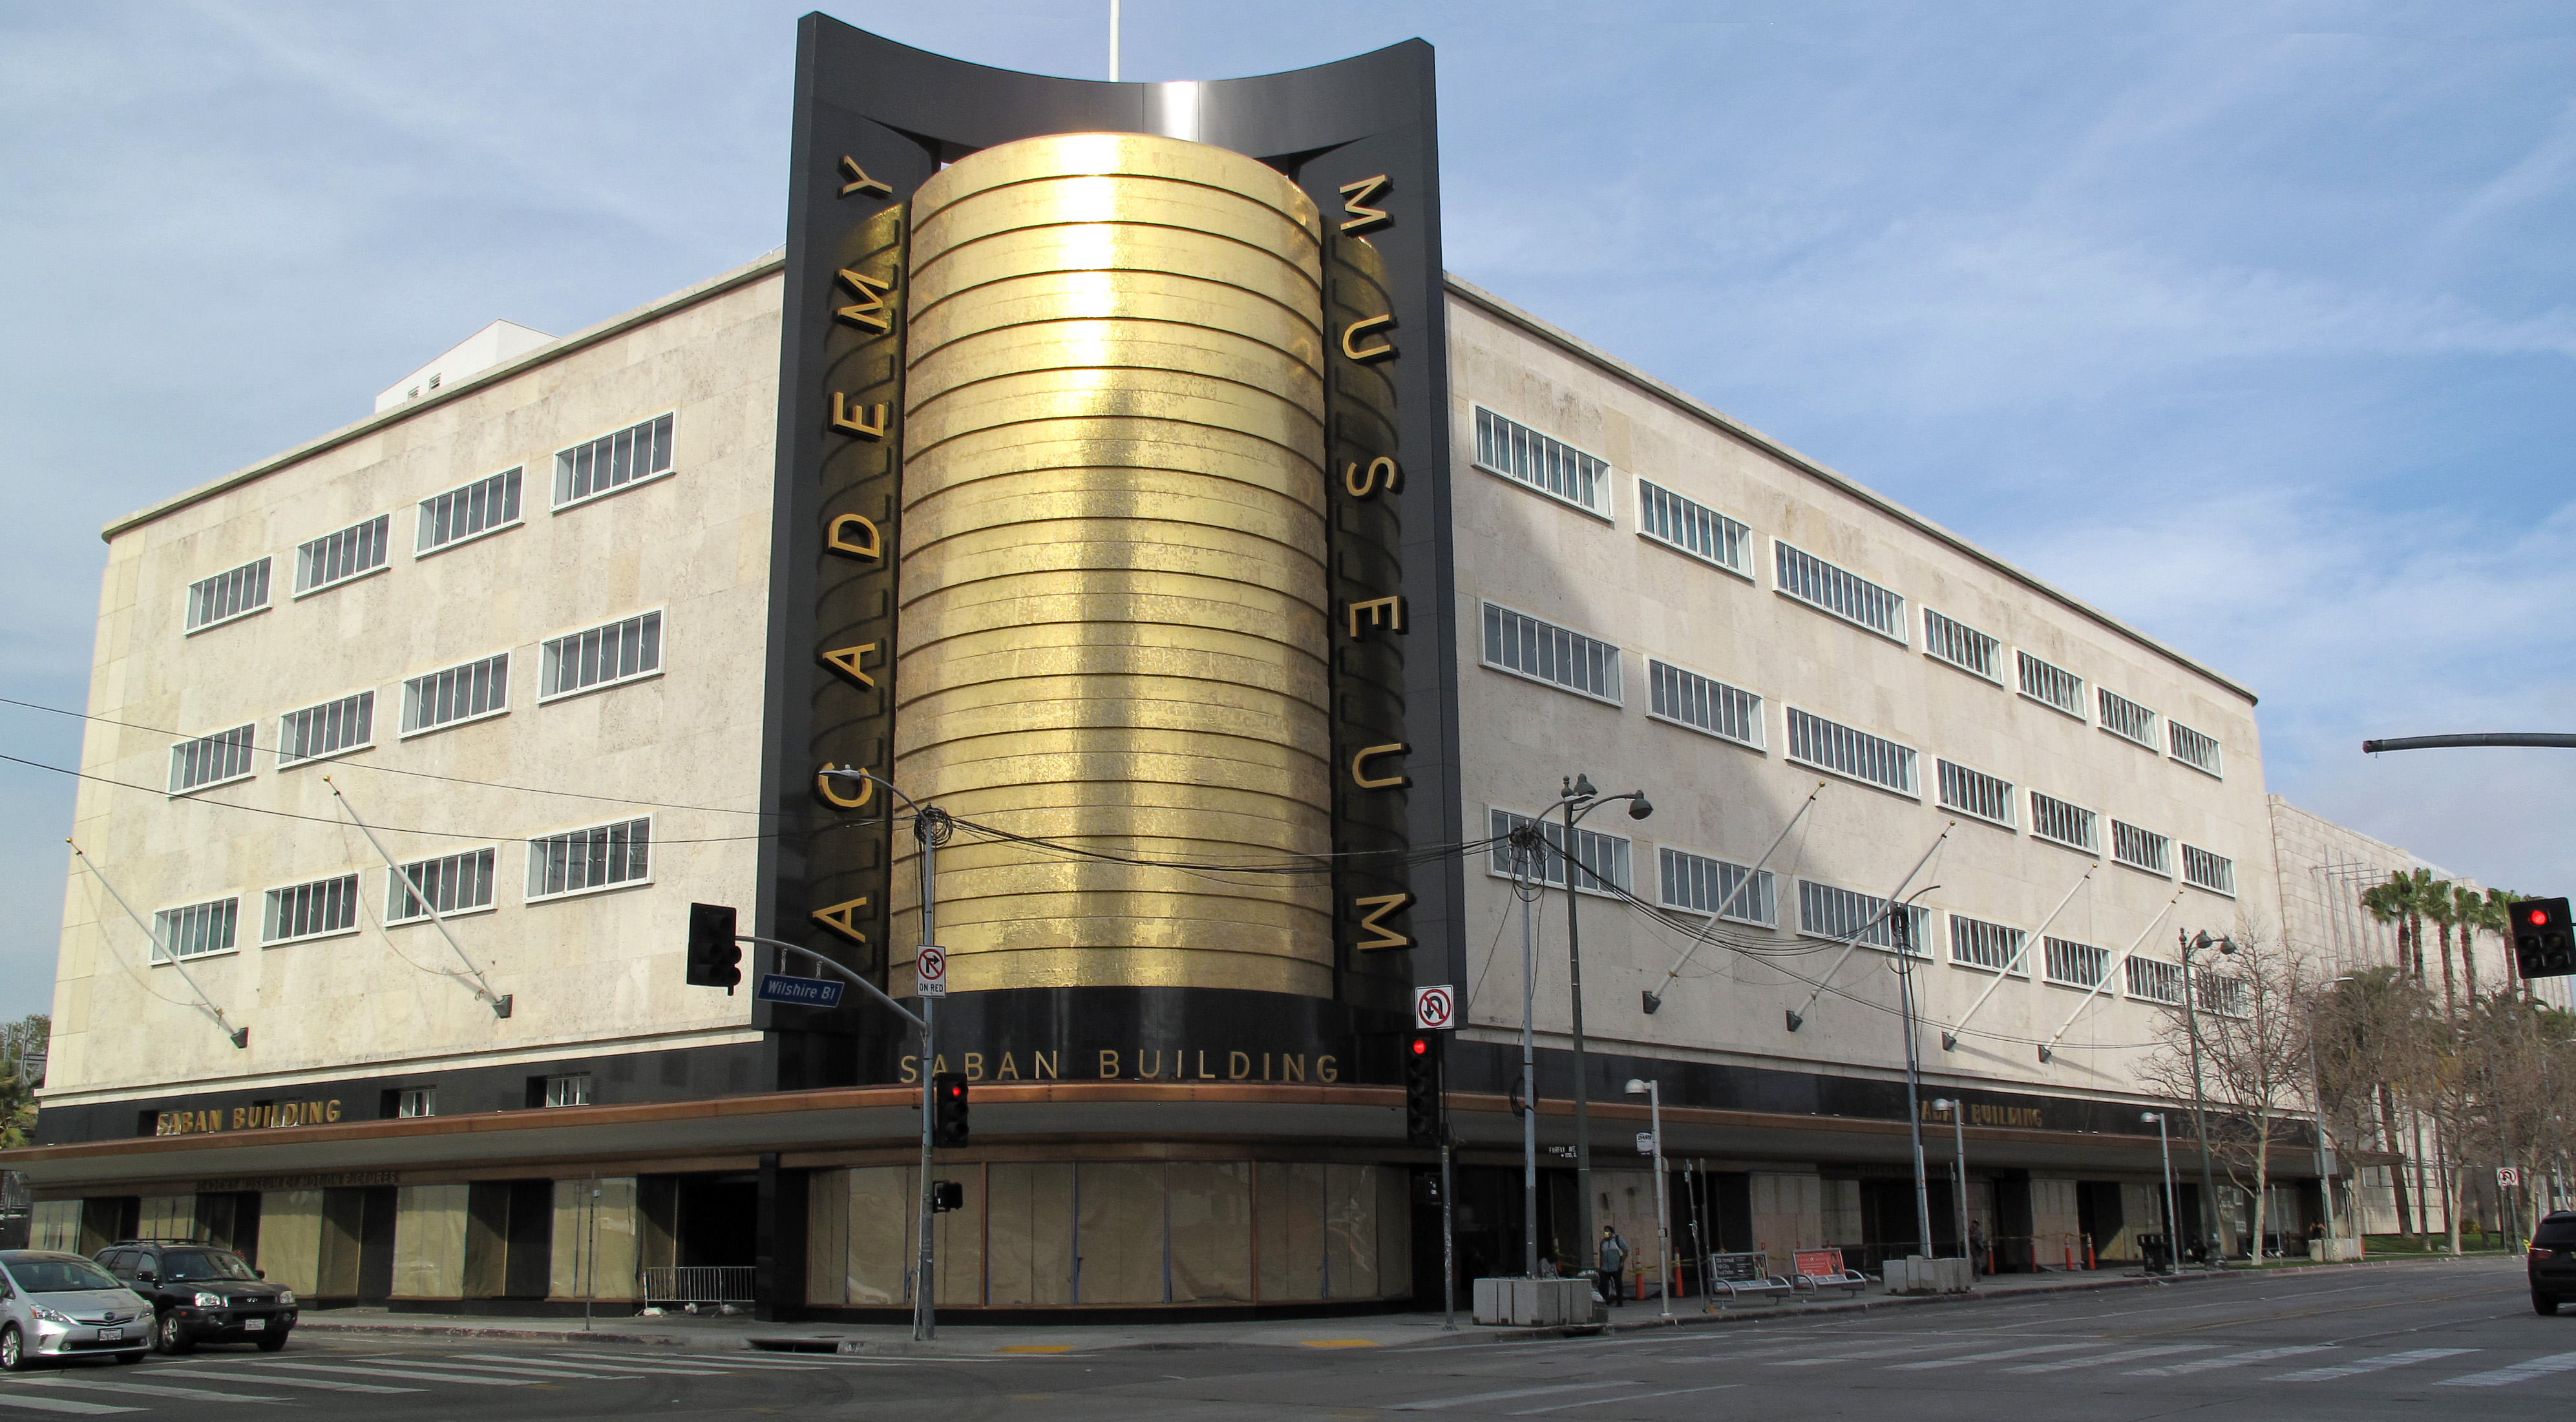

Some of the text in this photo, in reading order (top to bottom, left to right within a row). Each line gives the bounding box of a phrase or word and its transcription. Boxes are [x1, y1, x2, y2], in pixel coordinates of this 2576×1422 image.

[810, 154, 893, 945] ACADEMY
[1339, 174, 1414, 952] MUSEUM
[768, 980, 836, 1000] Wilshire Bl
[919, 983, 944, 992] ON RED
[900, 1049, 1338, 1084] SABAN BUILDING
[156, 1100, 341, 1135] SABAN BUILDING
[1971, 1103, 2043, 1127] BUILDING
[299, 1173, 341, 1187] MOTION
[344, 1171, 396, 1184] PICTURES
